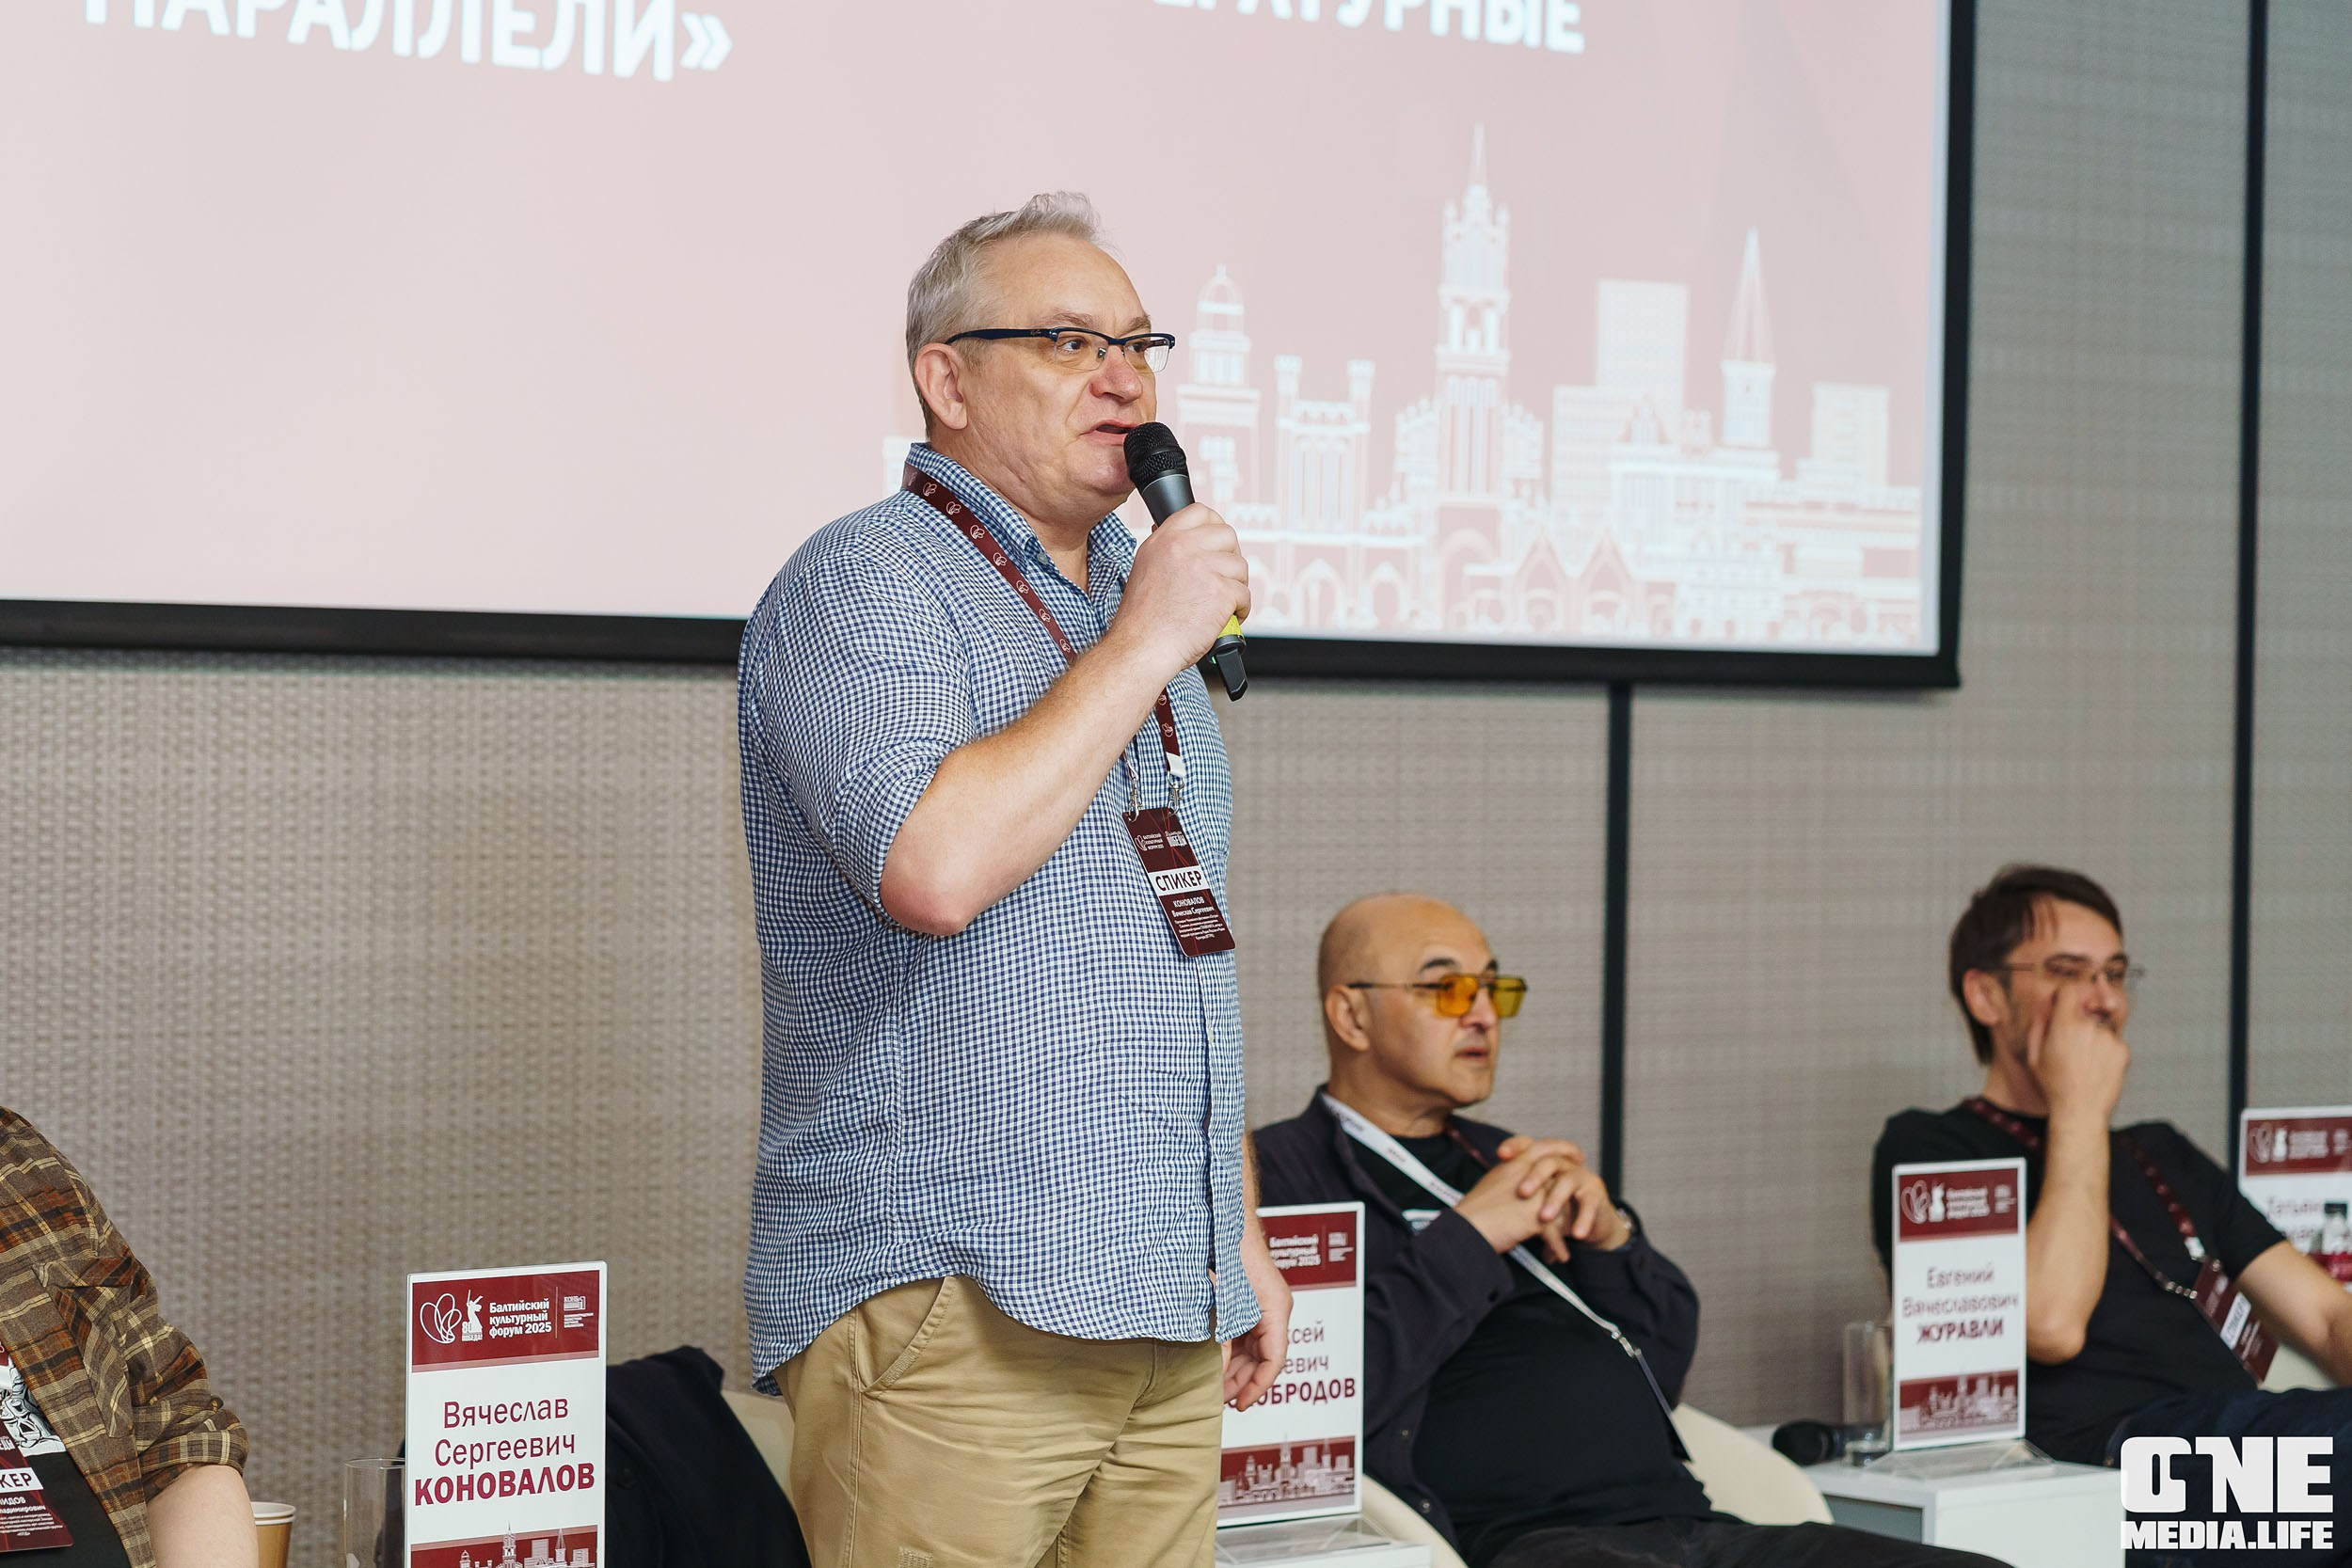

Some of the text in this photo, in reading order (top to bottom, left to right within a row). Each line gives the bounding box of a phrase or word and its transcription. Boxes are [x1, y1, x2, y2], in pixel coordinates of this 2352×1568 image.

[1155, 870, 1202, 891] СПИКЕР
[489, 1298, 549, 1313] Балтийский
[489, 1310, 548, 1326] культурный
[489, 1322, 551, 1338] форум 2025
[1288, 1319, 1325, 1343] сей
[444, 1399, 568, 1428] Вячеслав
[436, 1434, 575, 1469] Сергеевич
[415, 1463, 595, 1506] КОНОВАЛОВ
[0, 1497, 26, 1505] ИДОВ
